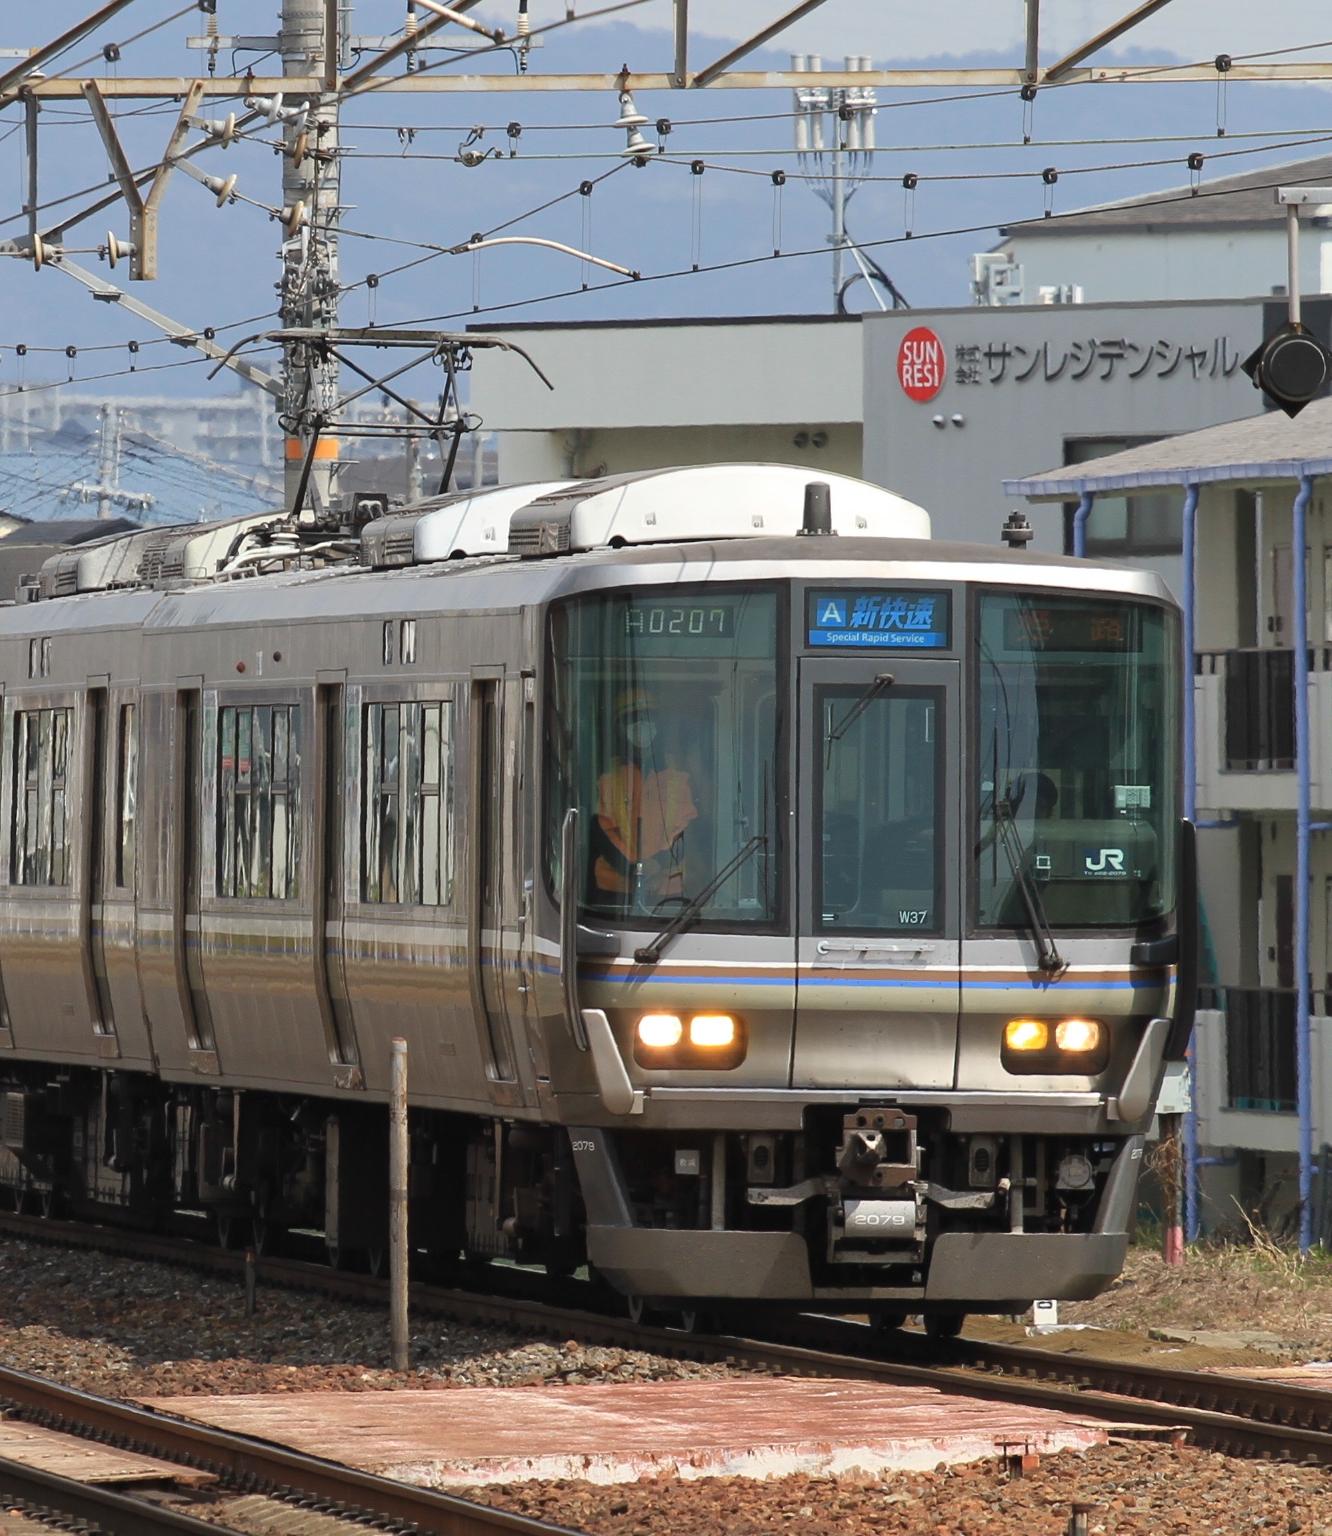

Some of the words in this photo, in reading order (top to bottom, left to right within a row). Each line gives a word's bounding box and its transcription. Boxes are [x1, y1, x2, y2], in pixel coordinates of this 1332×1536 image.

[903, 341, 938, 364] SUN
[955, 344, 981, 363] 株式
[983, 336, 1241, 384] サンレジデンシャル
[902, 363, 939, 388] RESI
[955, 365, 981, 384] 会社
[626, 608, 725, 633] A0207
[821, 602, 842, 623] A
[849, 596, 938, 630] 新快速
[826, 632, 860, 643] Special
[861, 633, 888, 643] Rapid
[891, 634, 925, 643] Service
[1085, 848, 1125, 871] JR
[899, 910, 928, 924] W37
[572, 1141, 595, 1151] 2079
[854, 1214, 906, 1226] 2079
